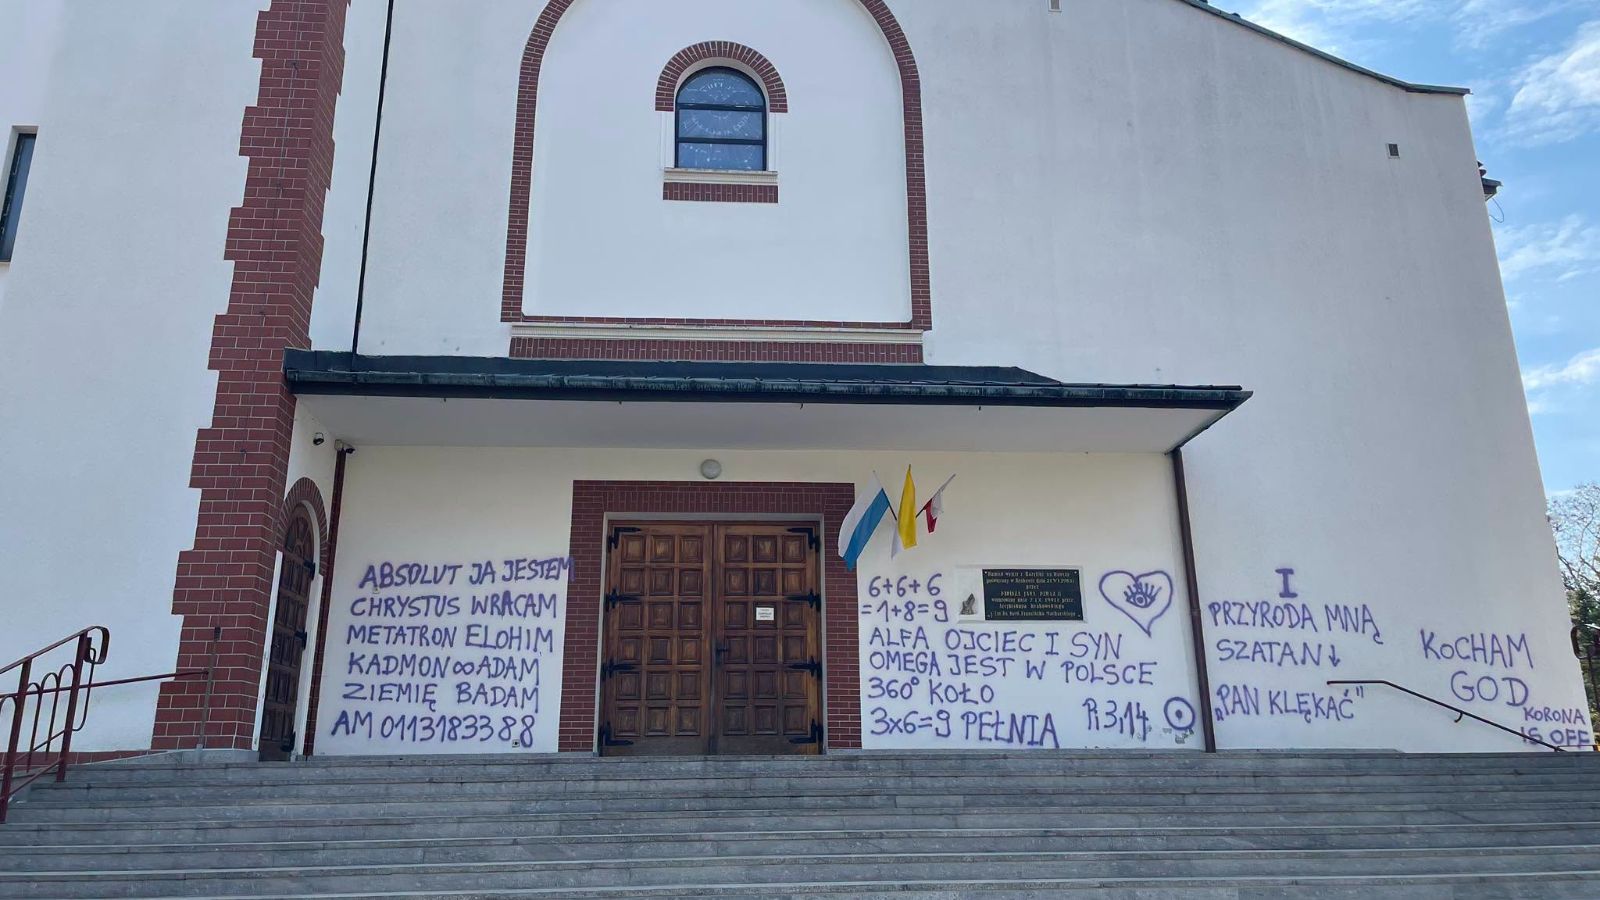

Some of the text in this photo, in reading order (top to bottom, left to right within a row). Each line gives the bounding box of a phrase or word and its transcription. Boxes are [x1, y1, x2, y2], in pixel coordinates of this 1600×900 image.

[358, 557, 575, 588] ABSOLUT JA JESTEM
[1274, 568, 1297, 598] I
[350, 590, 557, 618] CHRYSTUS WRACAM
[1208, 601, 1384, 645] PRZYRODA MNĄ
[346, 624, 553, 653] METATRON ELOHIM
[869, 626, 1122, 660] ALFA OJCIEC I SYN
[1216, 638, 1322, 667] SZATAN
[869, 651, 1158, 686] OMEGA JEST W POLSCE
[342, 682, 539, 713] ZIEMIĘ BADAM
[867, 676, 995, 705] 360° KOŁO
[1450, 670, 1529, 707] GOD
[331, 710, 372, 739] AM
[961, 711, 1059, 749] PEŁNIA
[1103, 700, 1149, 742] 3,14
[1522, 705, 1586, 726] KORONA
[1520, 726, 1591, 748] IS OFF
